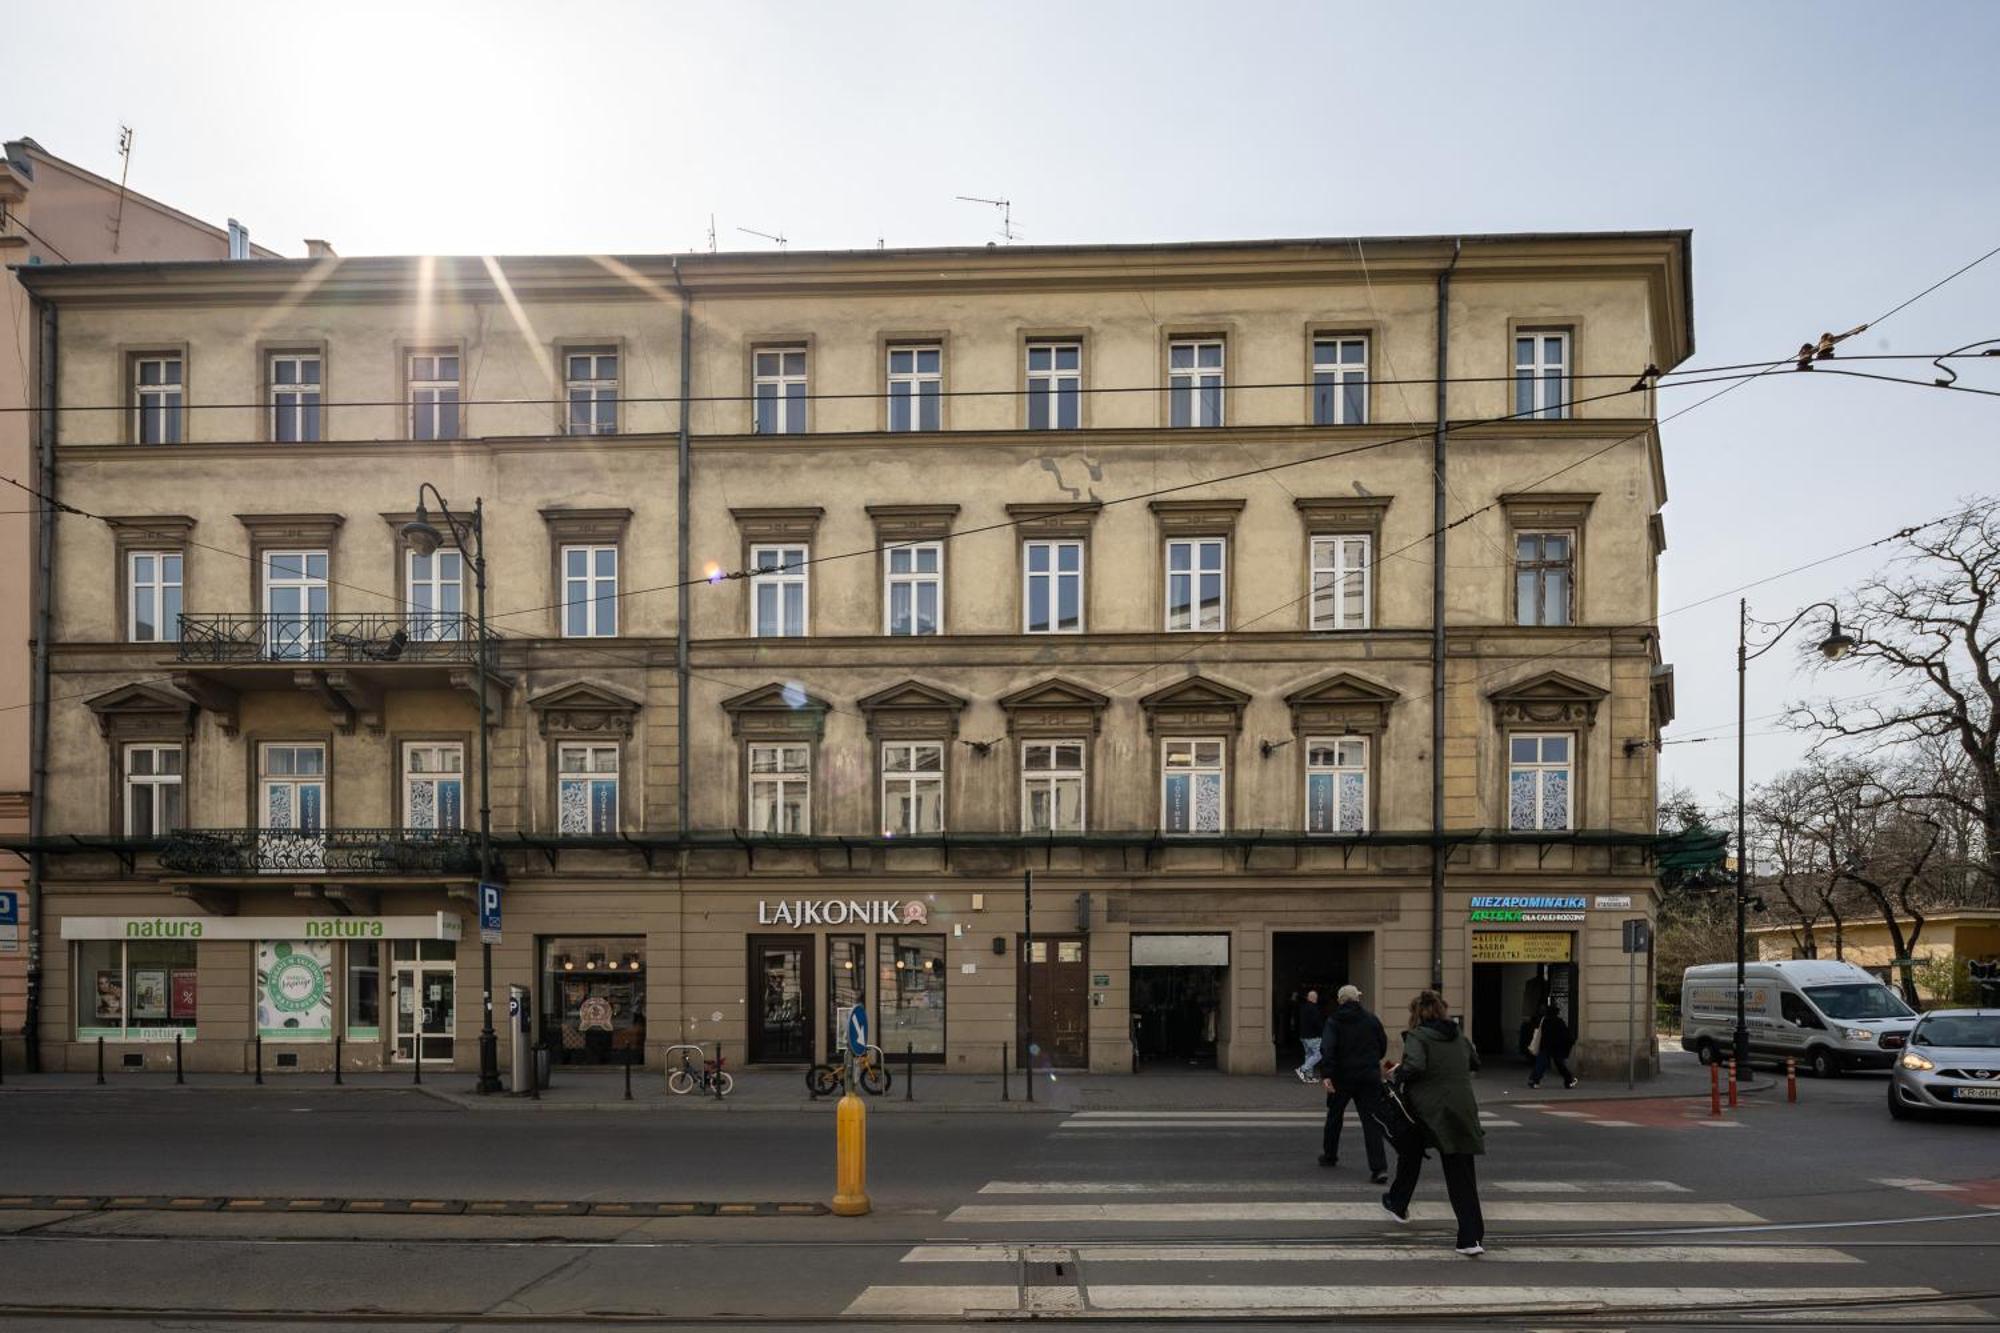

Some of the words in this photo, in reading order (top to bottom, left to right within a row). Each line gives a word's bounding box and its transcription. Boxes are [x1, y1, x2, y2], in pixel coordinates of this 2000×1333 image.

[485, 888, 497, 915] P
[1471, 896, 1587, 908] NIEZAPOMINAJKA
[759, 900, 901, 928] LAJKONIK
[1471, 910, 1521, 921] APTEKA
[126, 918, 203, 937] natura
[306, 918, 383, 937] natura
[510, 1001, 517, 1012] P
